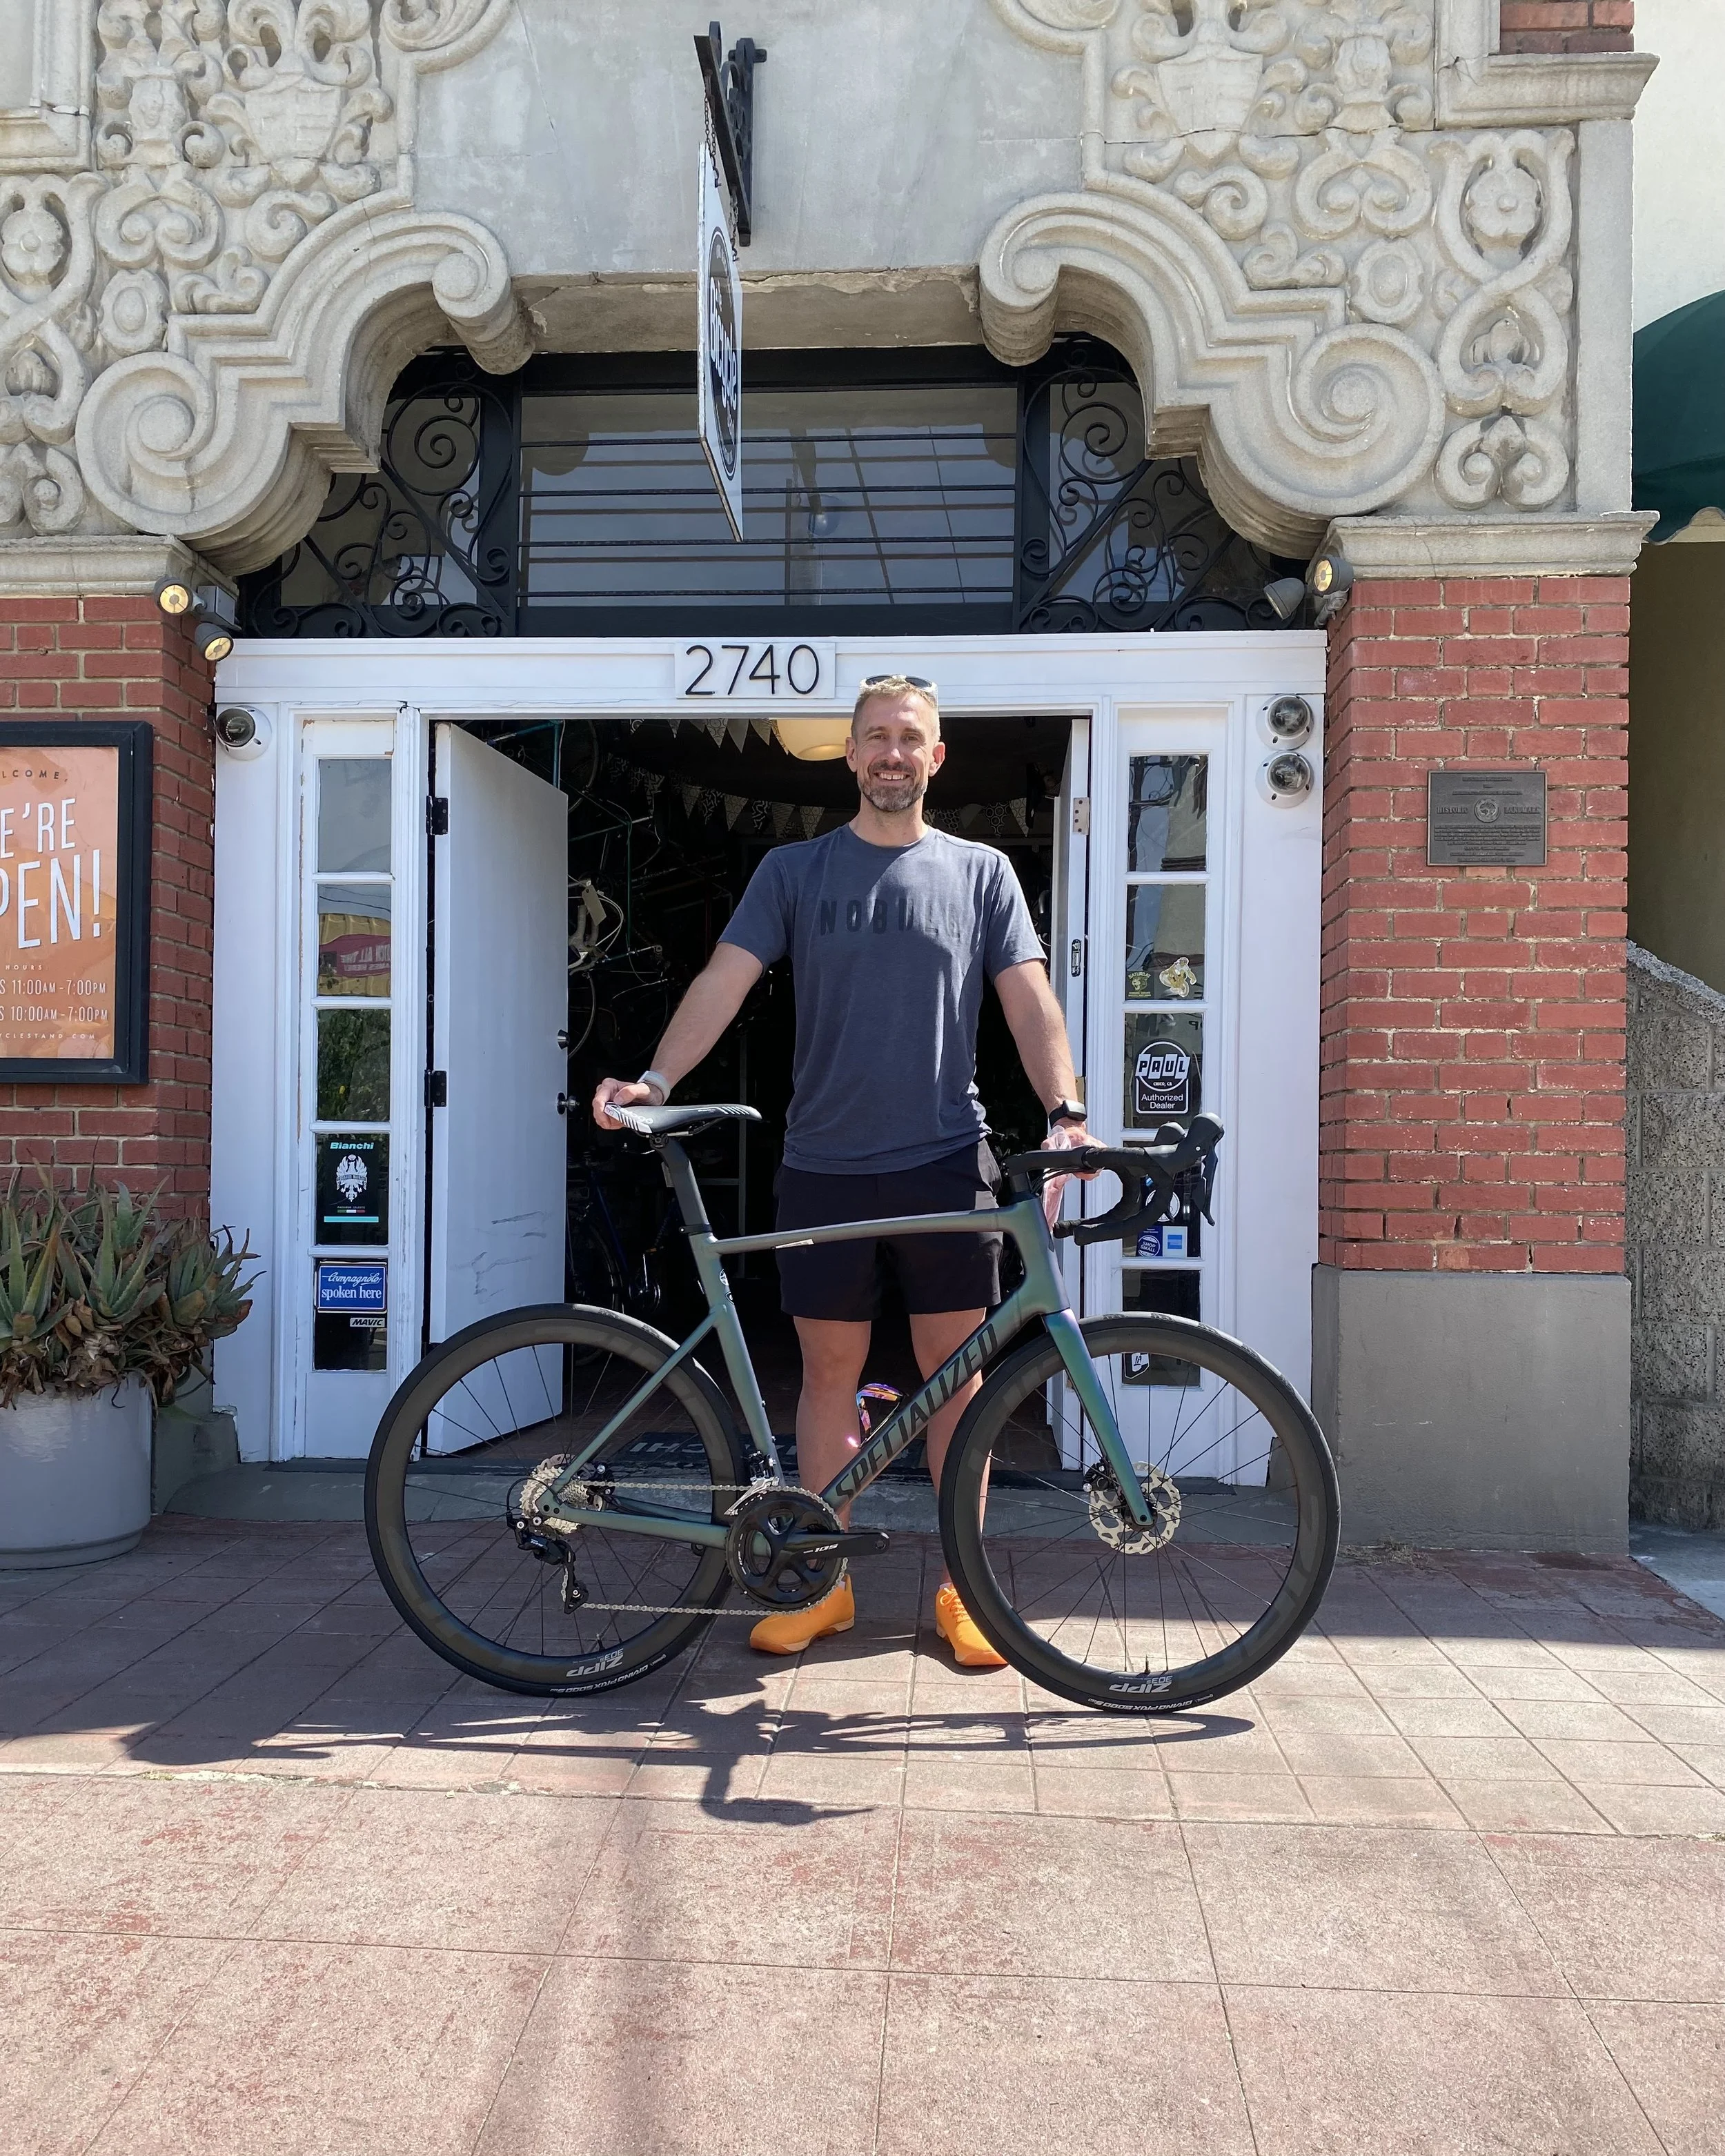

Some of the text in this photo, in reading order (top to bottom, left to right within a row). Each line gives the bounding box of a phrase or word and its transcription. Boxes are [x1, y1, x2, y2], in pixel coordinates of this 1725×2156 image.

[709, 277, 737, 411] Bicycle
[685, 644, 819, 695] 2740
[1137, 1059, 1187, 1074] PAUL
[1150, 1101, 1176, 1109] Dealer
[322, 1272, 382, 1287] Campagnolo
[321, 1285, 382, 1300] spoken here
[835, 1323, 998, 1500] SPECIALIZED
[814, 1543, 839, 1552] 105
[566, 1656, 624, 1677] ZIPP
[618, 1664, 649, 1682] GRAND
[593, 1678, 617, 1688] PRIX
[1109, 1682, 1172, 1693] ZIPP
[1103, 1702, 1134, 1710] 5000
[1159, 1699, 1193, 1710] GRAND
